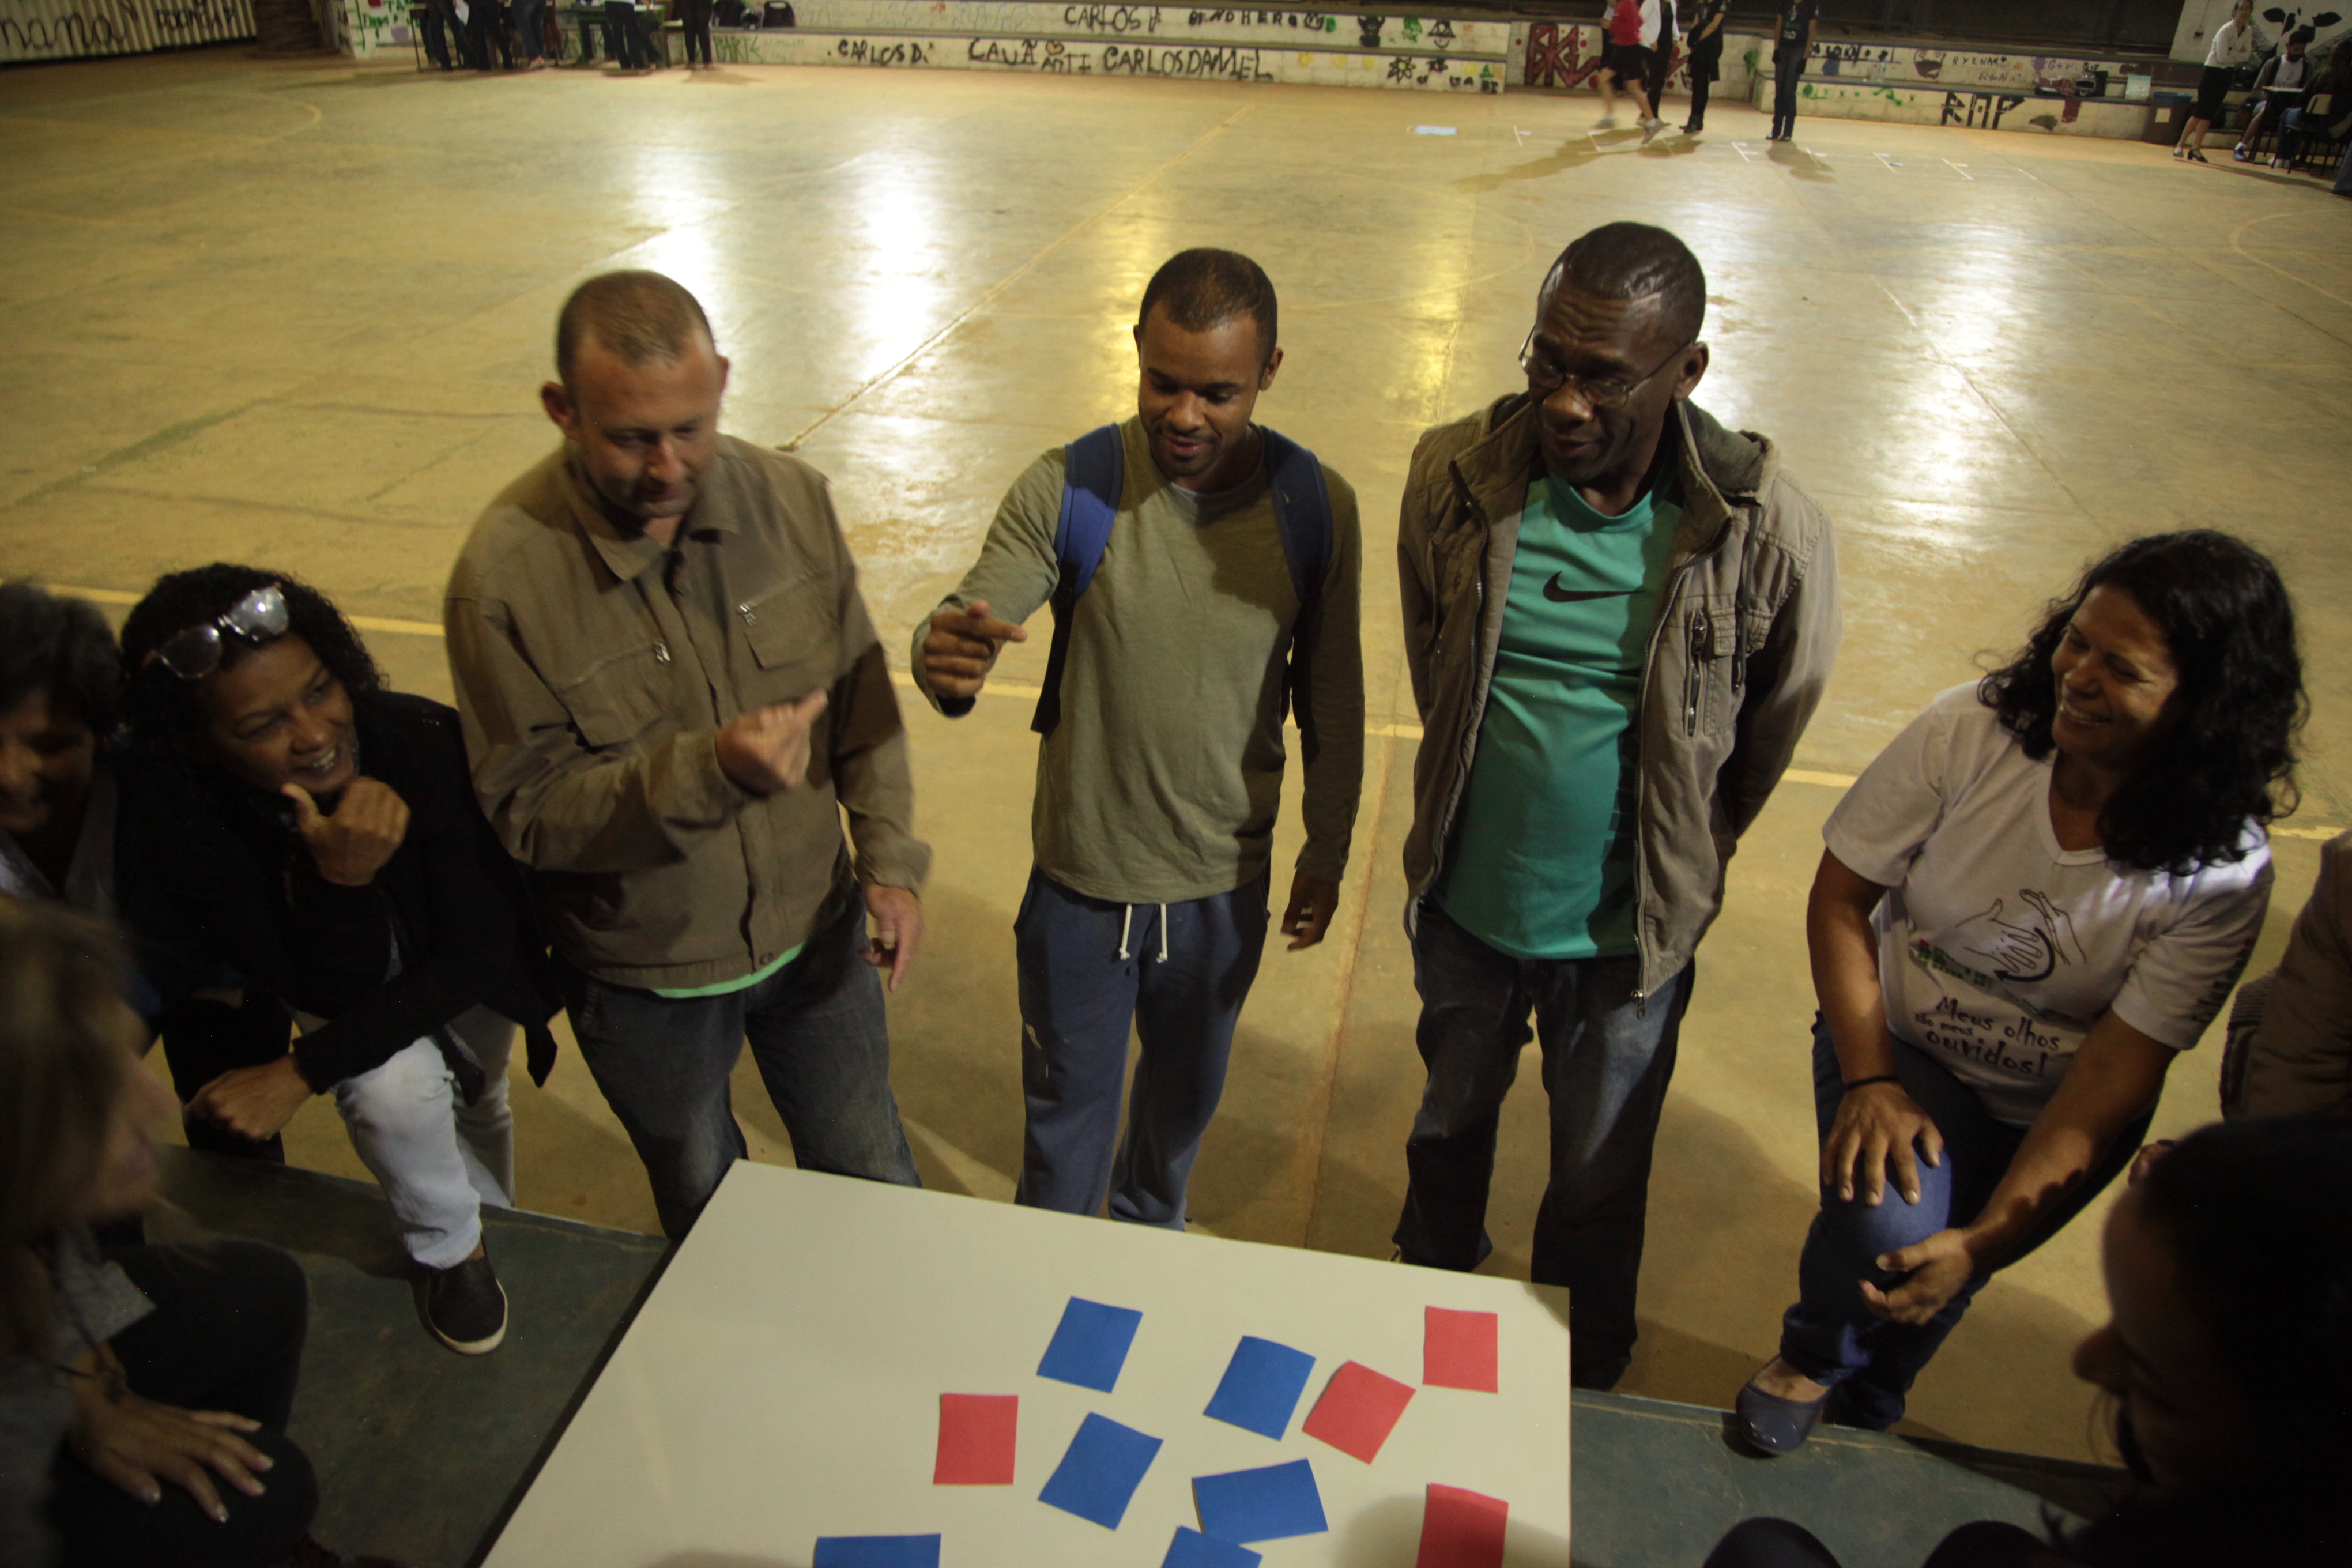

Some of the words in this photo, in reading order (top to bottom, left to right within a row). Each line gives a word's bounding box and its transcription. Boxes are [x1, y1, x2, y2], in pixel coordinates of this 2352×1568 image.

[838, 39, 906, 66] CARLOS
[1935, 996, 1994, 1031] Meus
[2004, 1016, 2060, 1051] olhos
